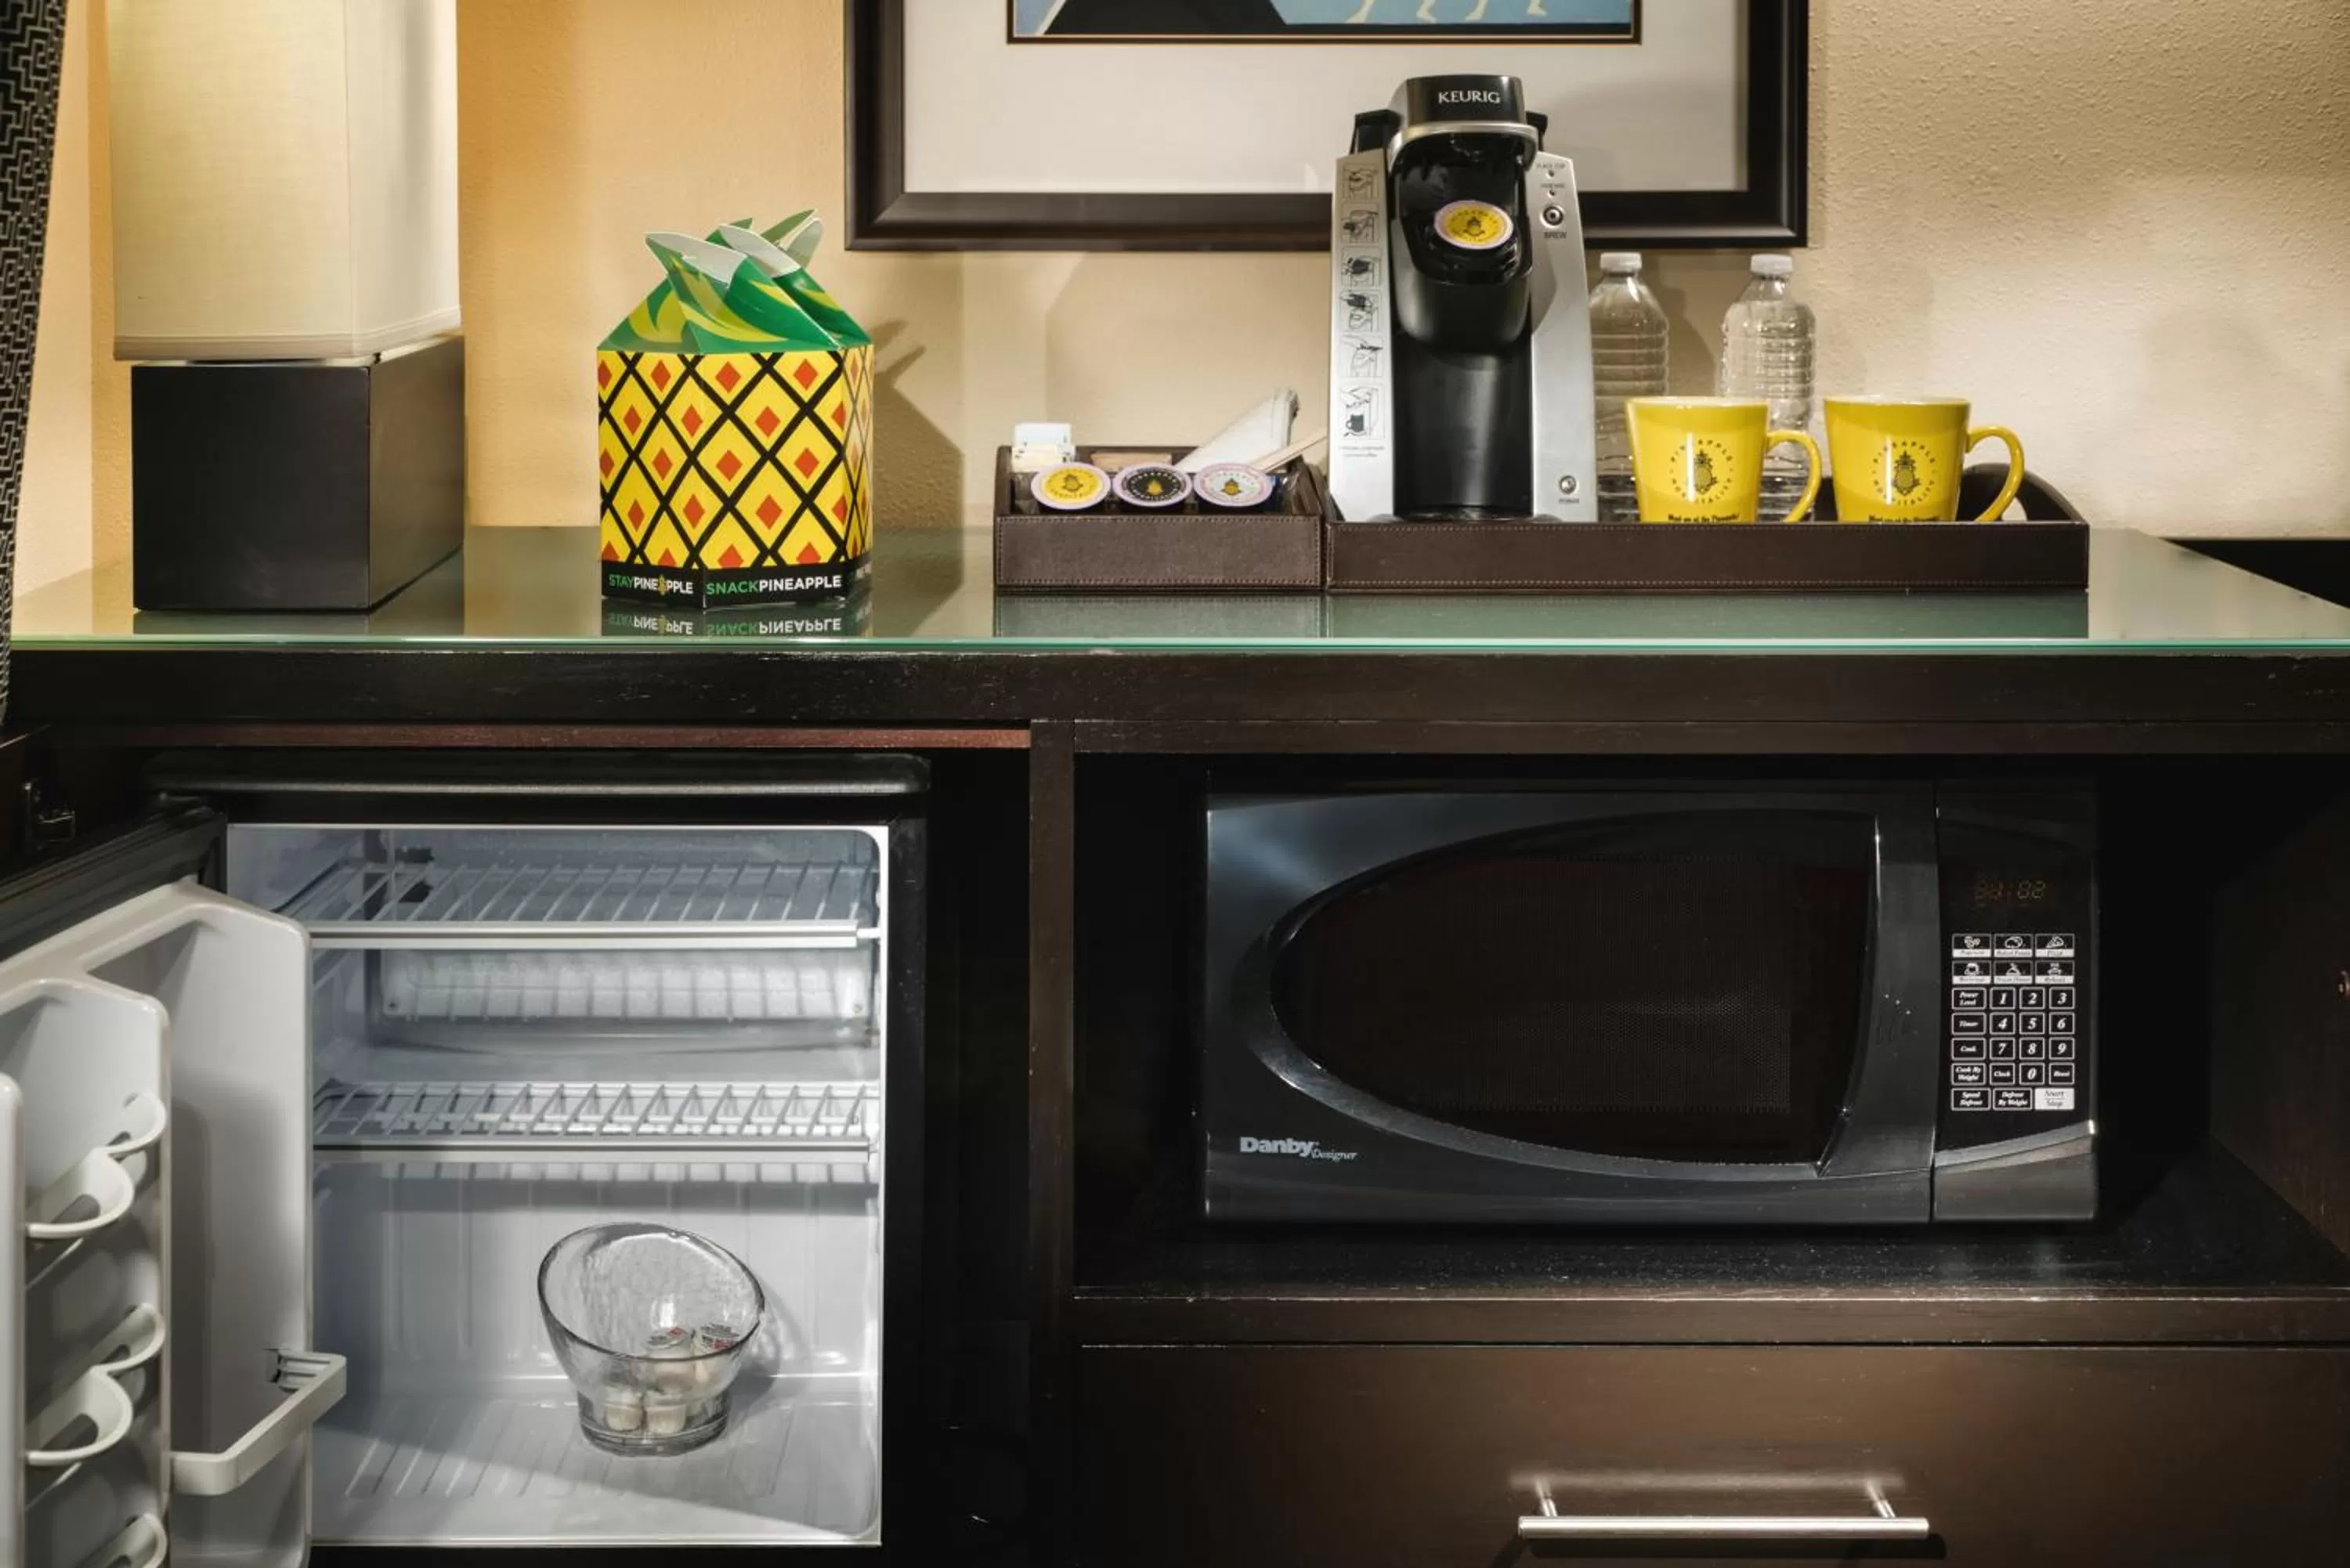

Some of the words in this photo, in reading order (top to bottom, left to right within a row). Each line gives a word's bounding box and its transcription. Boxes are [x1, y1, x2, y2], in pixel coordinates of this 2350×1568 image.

[1438, 90, 1501, 104] KEURIG
[707, 575, 841, 594] SNACKPINEAPPLE
[1999, 992, 2008, 1005] 1
[2028, 992, 2037, 1005] 2
[2057, 992, 2067, 1005] 3
[1998, 1017, 2008, 1030] 4
[2027, 1017, 2037, 1030] 5
[2057, 1017, 2067, 1030] 6
[1998, 1042, 2007, 1055] 7
[2027, 1042, 2037, 1055] 8
[2057, 1042, 2067, 1055] 9
[2027, 1068, 2037, 1080] 0
[1239, 1136, 1314, 1157] Danby
[1312, 1149, 1358, 1163] Designer
